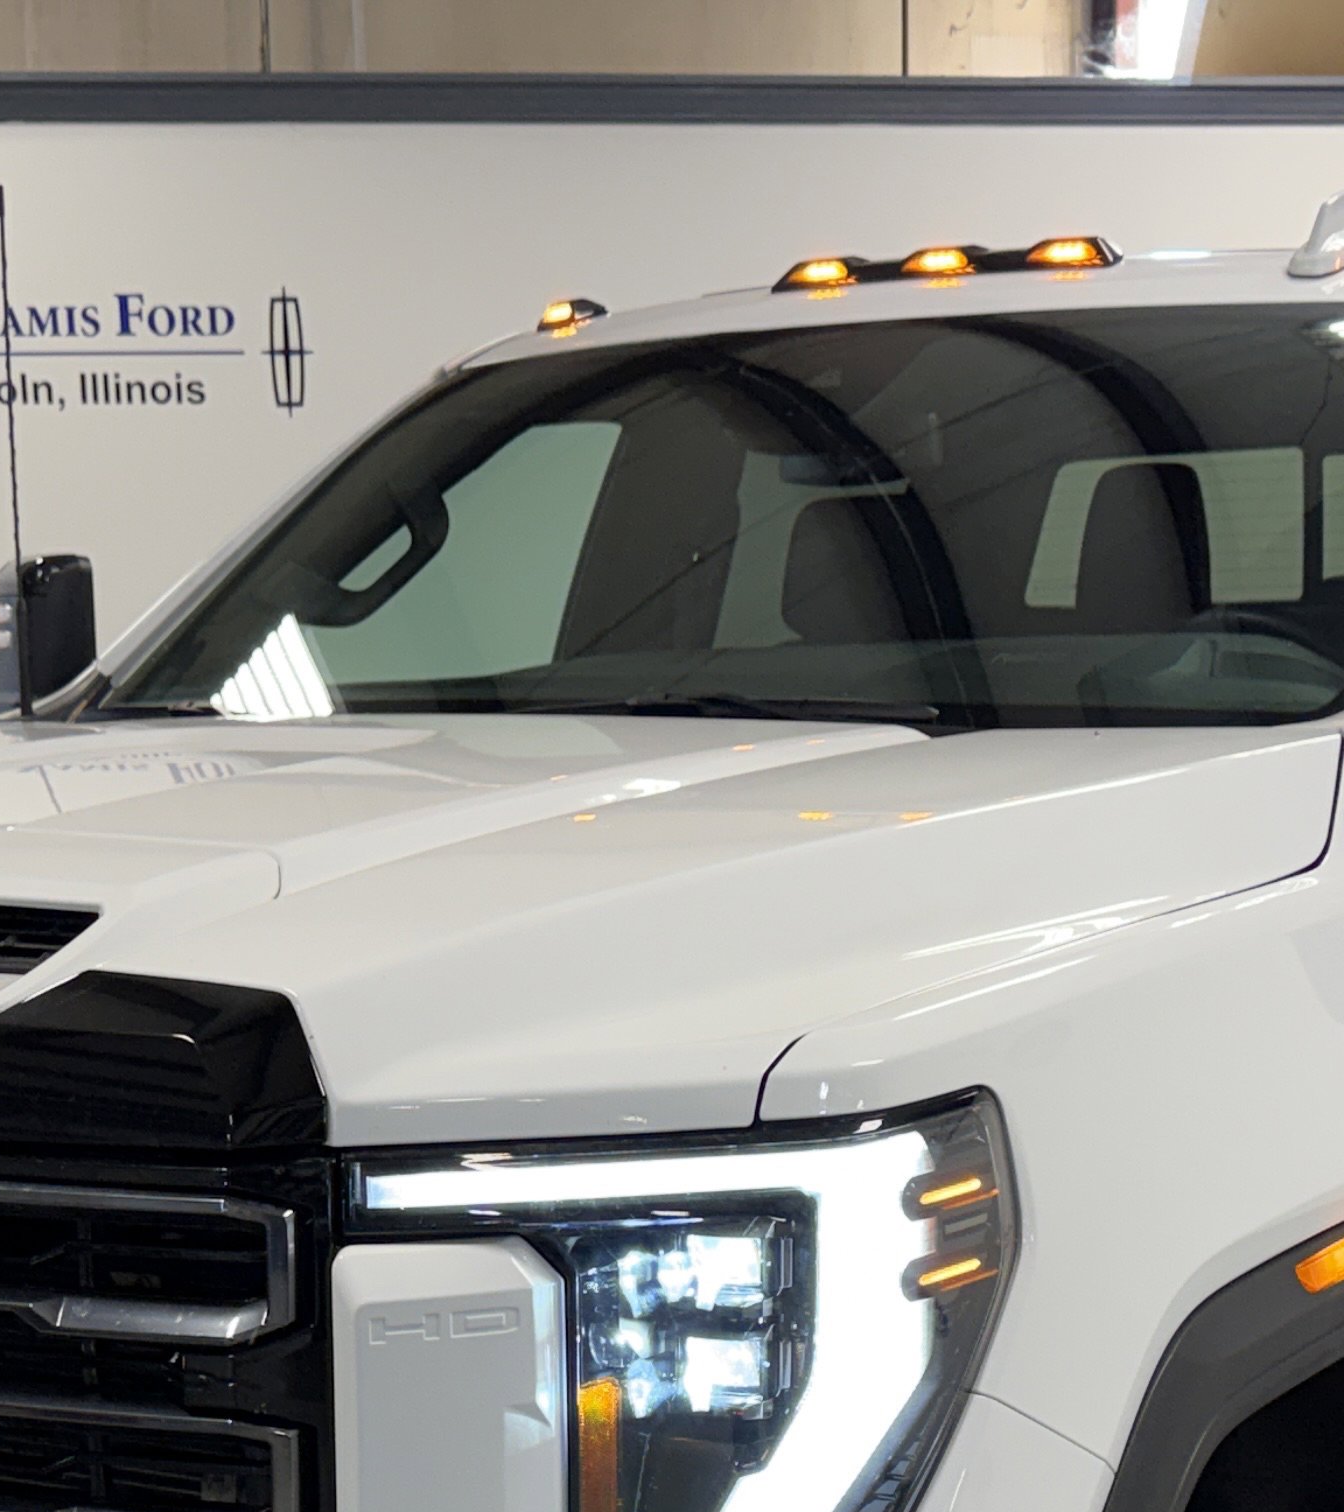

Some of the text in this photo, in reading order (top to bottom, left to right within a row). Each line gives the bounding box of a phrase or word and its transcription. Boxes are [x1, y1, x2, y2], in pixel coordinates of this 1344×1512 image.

[114, 294, 236, 337] FORD
[80, 373, 206, 405] Illinois
[368, 1307, 519, 1345] HD
